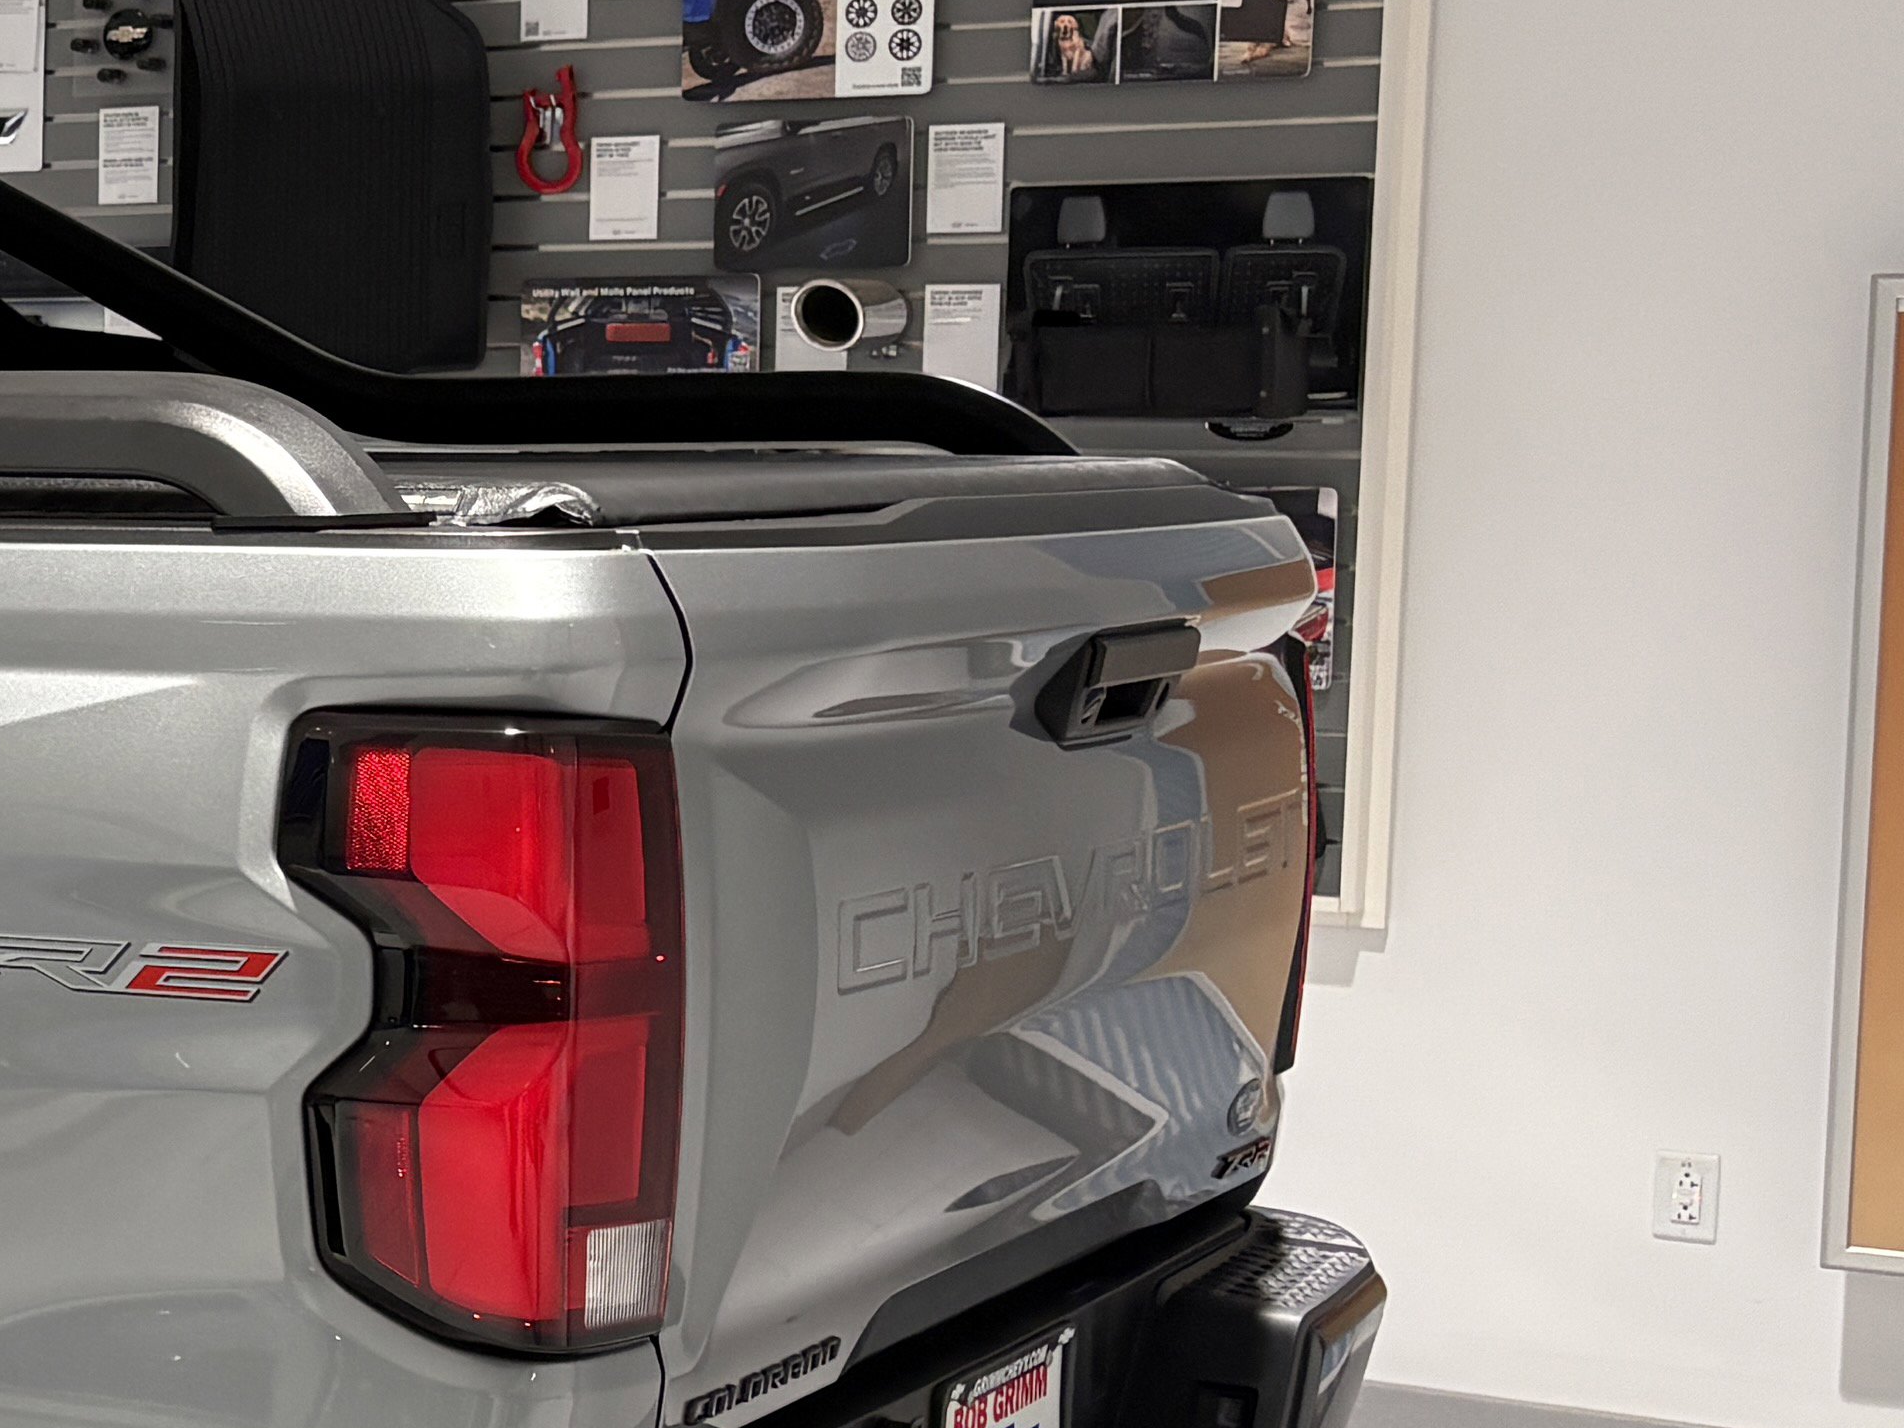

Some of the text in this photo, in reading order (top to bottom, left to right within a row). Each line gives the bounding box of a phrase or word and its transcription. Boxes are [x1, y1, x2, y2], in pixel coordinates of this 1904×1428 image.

[581, 286, 599, 297] and
[837, 786, 1304, 995] CHEVROLET
[681, 1334, 842, 1427] COLORADO
[993, 1363, 1048, 1424] GRIMM
